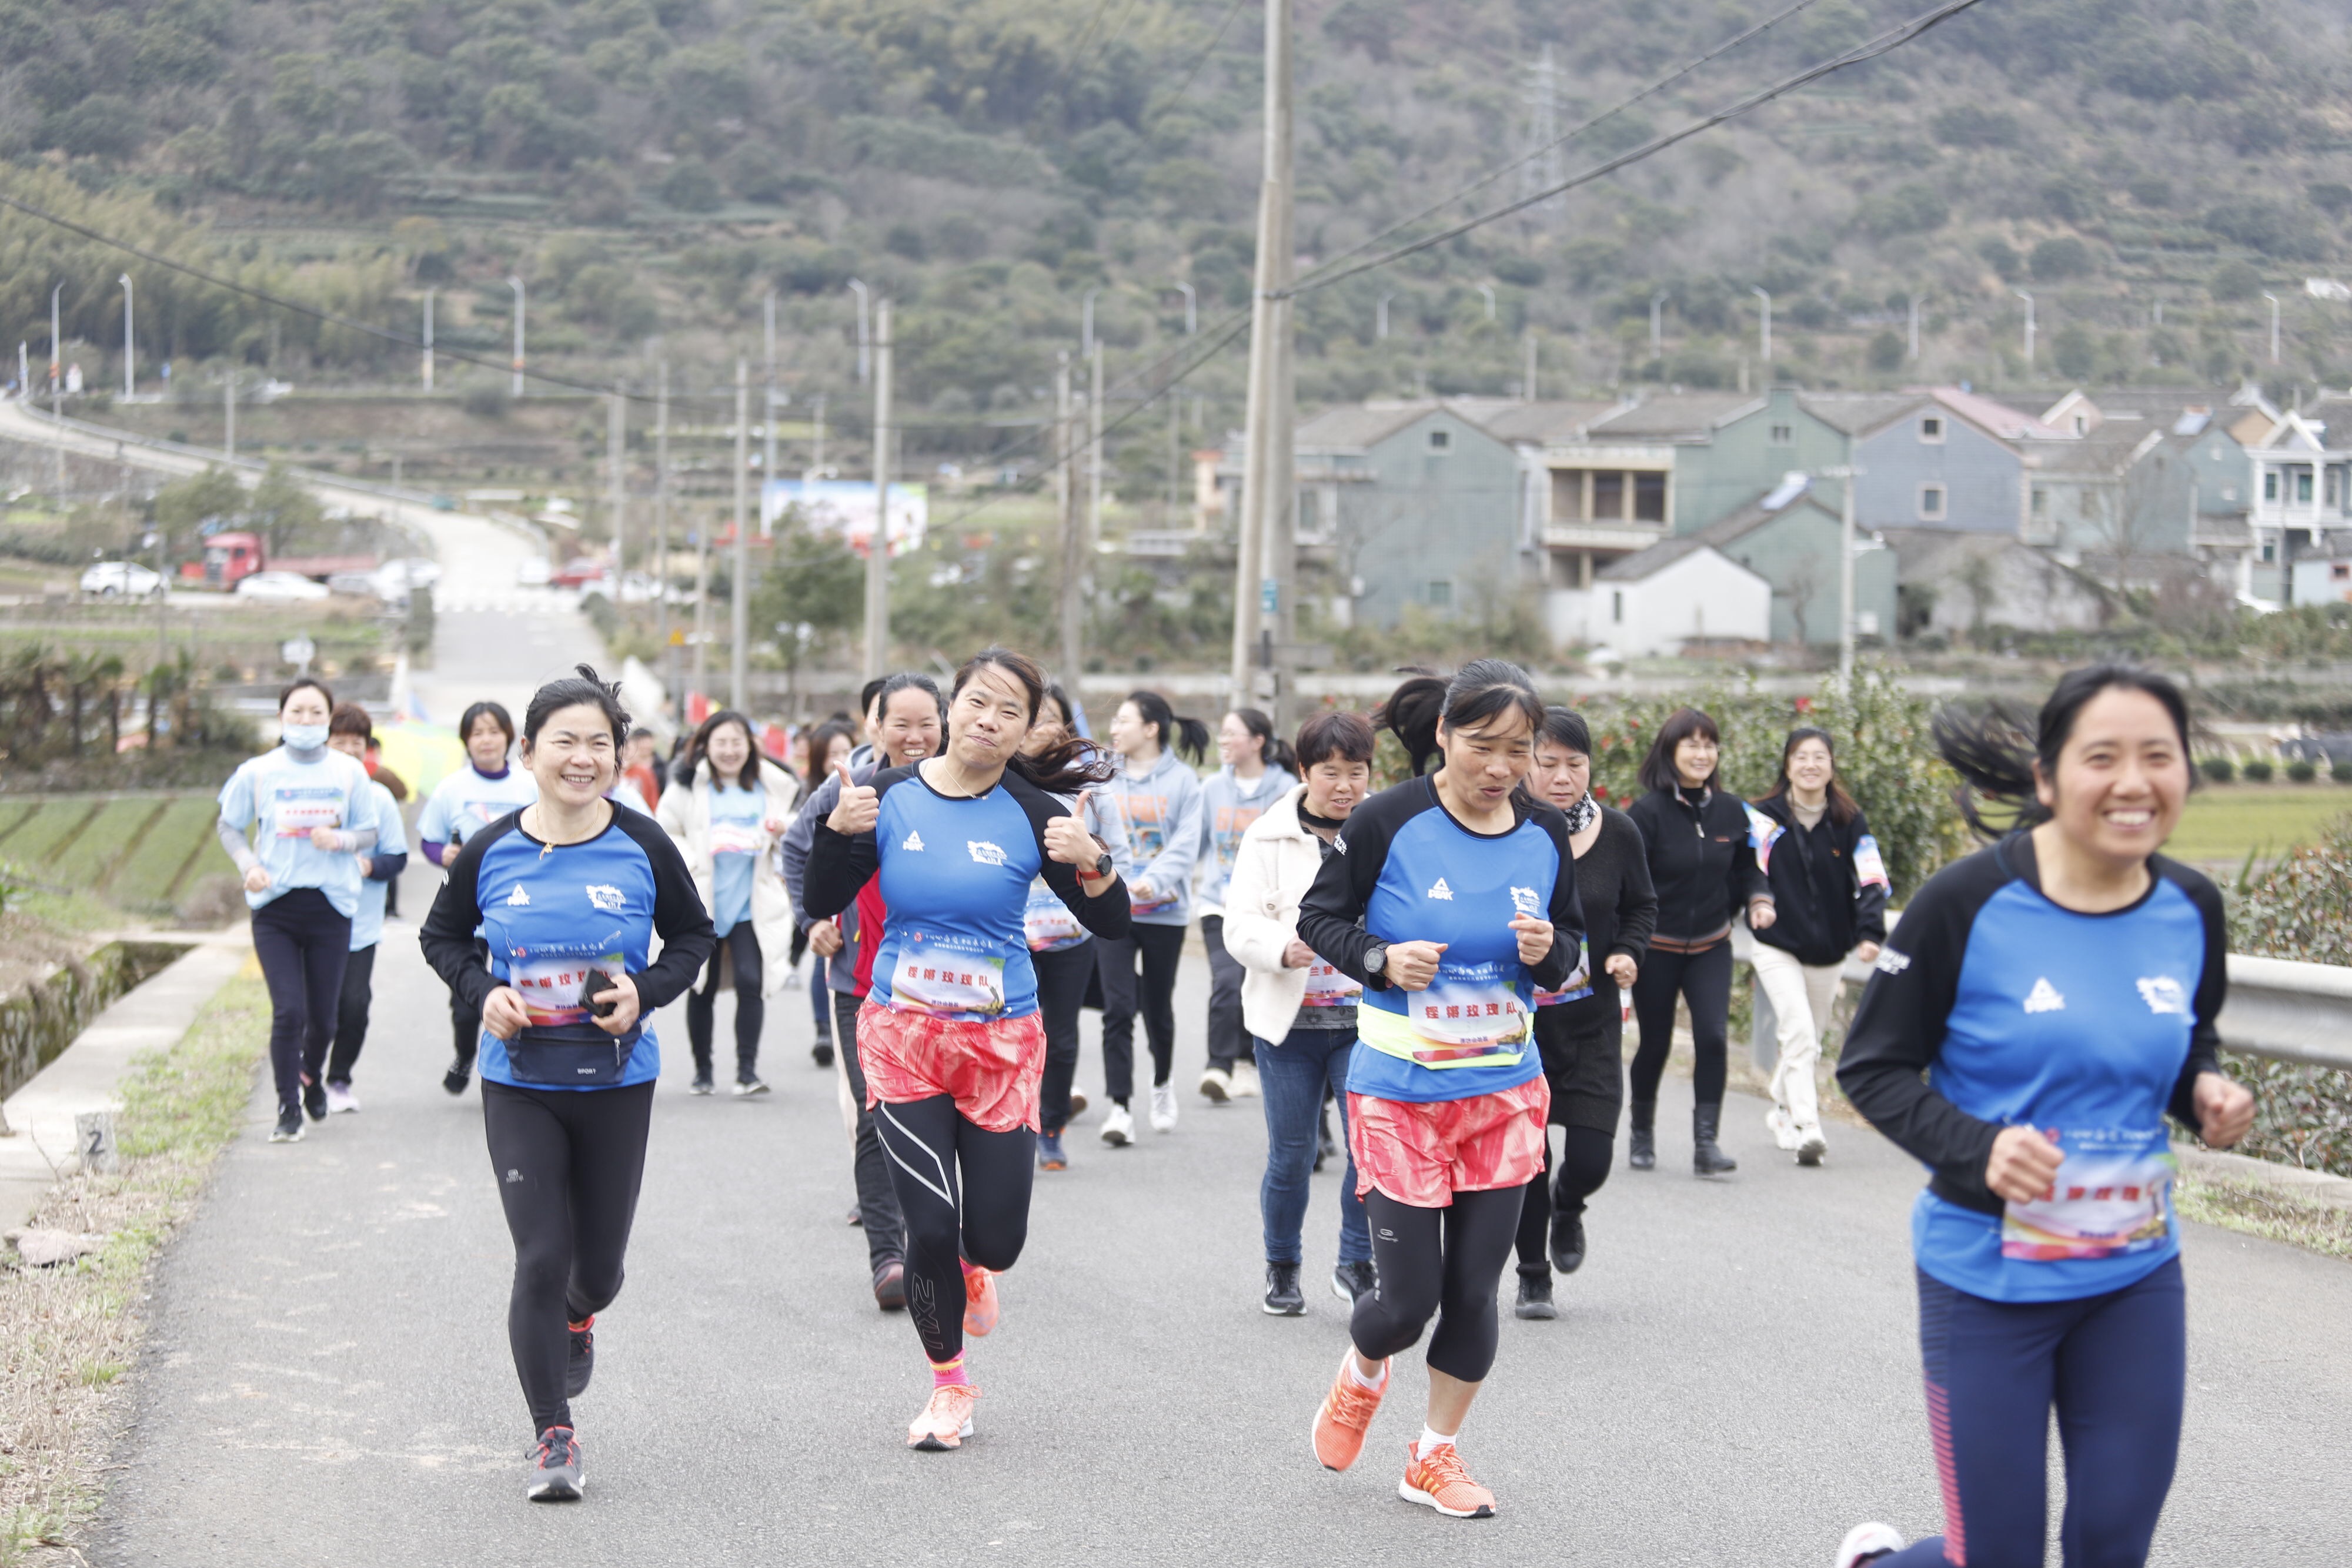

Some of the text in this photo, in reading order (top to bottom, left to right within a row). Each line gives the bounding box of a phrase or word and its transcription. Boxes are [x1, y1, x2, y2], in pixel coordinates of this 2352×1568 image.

[1428, 888, 1454, 901] PEAK
[86, 1130, 106, 1155] 2
[911, 1272, 944, 1350] 2XU
